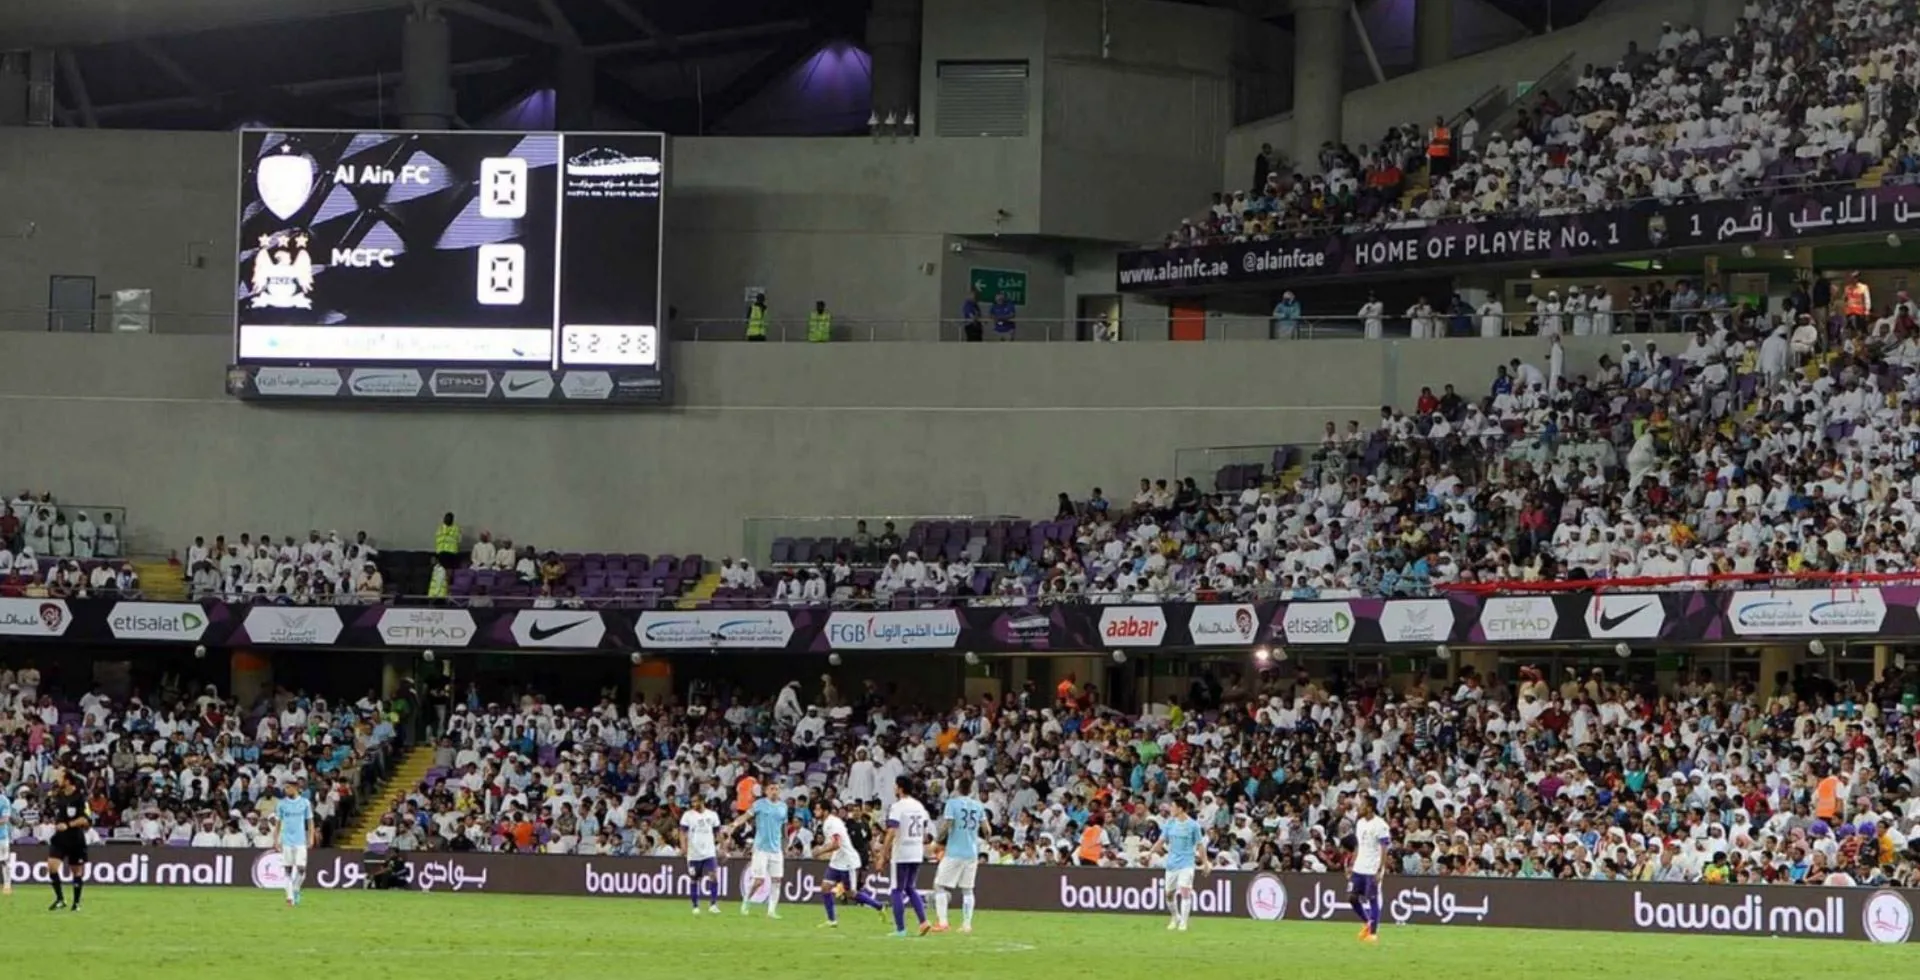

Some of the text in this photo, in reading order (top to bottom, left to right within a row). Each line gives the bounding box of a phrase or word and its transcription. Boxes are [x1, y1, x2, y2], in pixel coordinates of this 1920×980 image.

[333, 165, 430, 183] Al Ain FC
[493, 170, 516, 205] 0
[1717, 206, 1773, 240] رقم
[1789, 195, 1877, 232] اللاعب
[331, 248, 395, 267] MCFC
[1355, 222, 1620, 265] HOME OF PLAYER No. 1
[490, 257, 513, 292] 0
[1120, 248, 1325, 284] www.alainfc.ae @alainfcae
[113, 614, 180, 632] etisalat
[386, 626, 467, 639] ETIHAD
[830, 624, 866, 643] FGB
[1106, 616, 1159, 638] aabar
[1287, 613, 1334, 634] etisalat
[1488, 617, 1550, 632] ETIHAD
[960, 808, 977, 831] 35
[9, 852, 233, 884] bawadi mall
[585, 863, 673, 895] bawadi
[1060, 875, 1165, 910] bawadi
[1300, 882, 1372, 919] ول
[1634, 892, 1844, 934] bawadi mall
